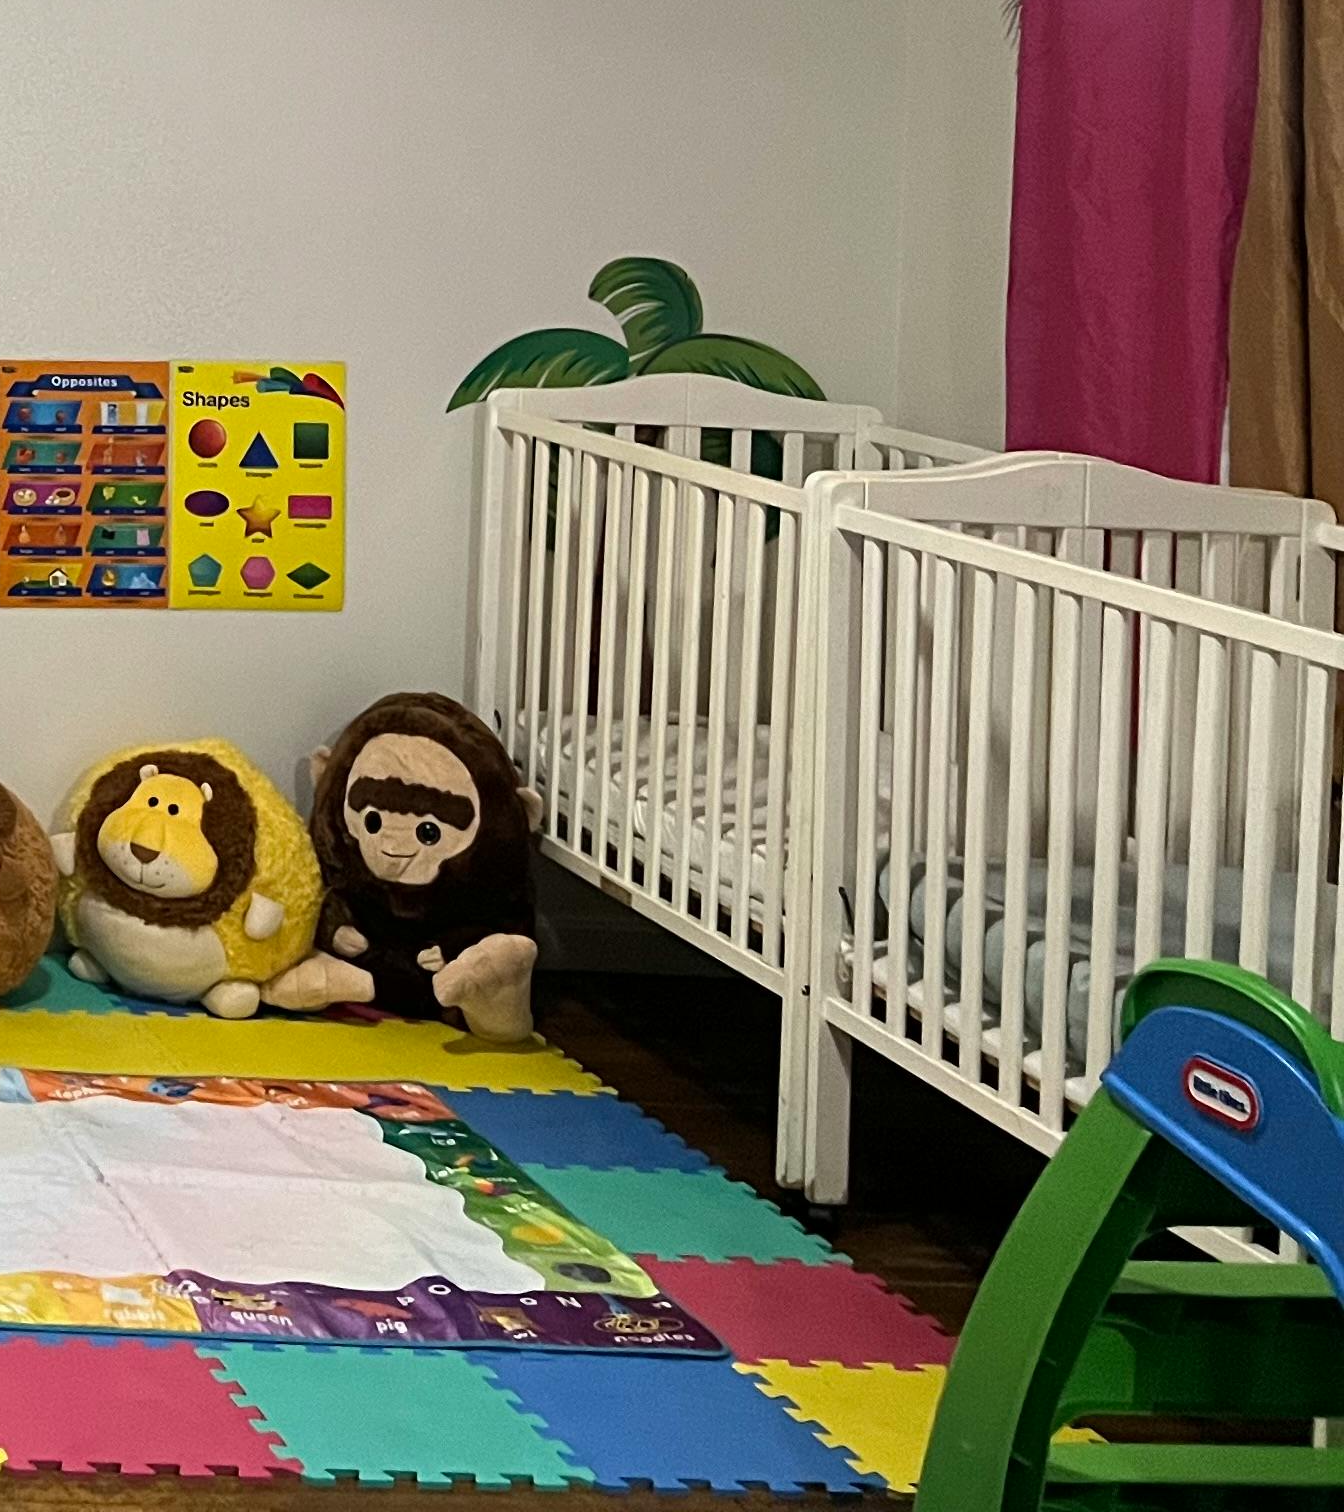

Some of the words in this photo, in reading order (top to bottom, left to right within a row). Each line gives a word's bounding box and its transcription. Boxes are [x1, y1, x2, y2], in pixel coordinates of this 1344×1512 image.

[51, 376, 118, 388] Opposites
[182, 391, 250, 410] Shapes
[376, 1319, 409, 1334] pig
